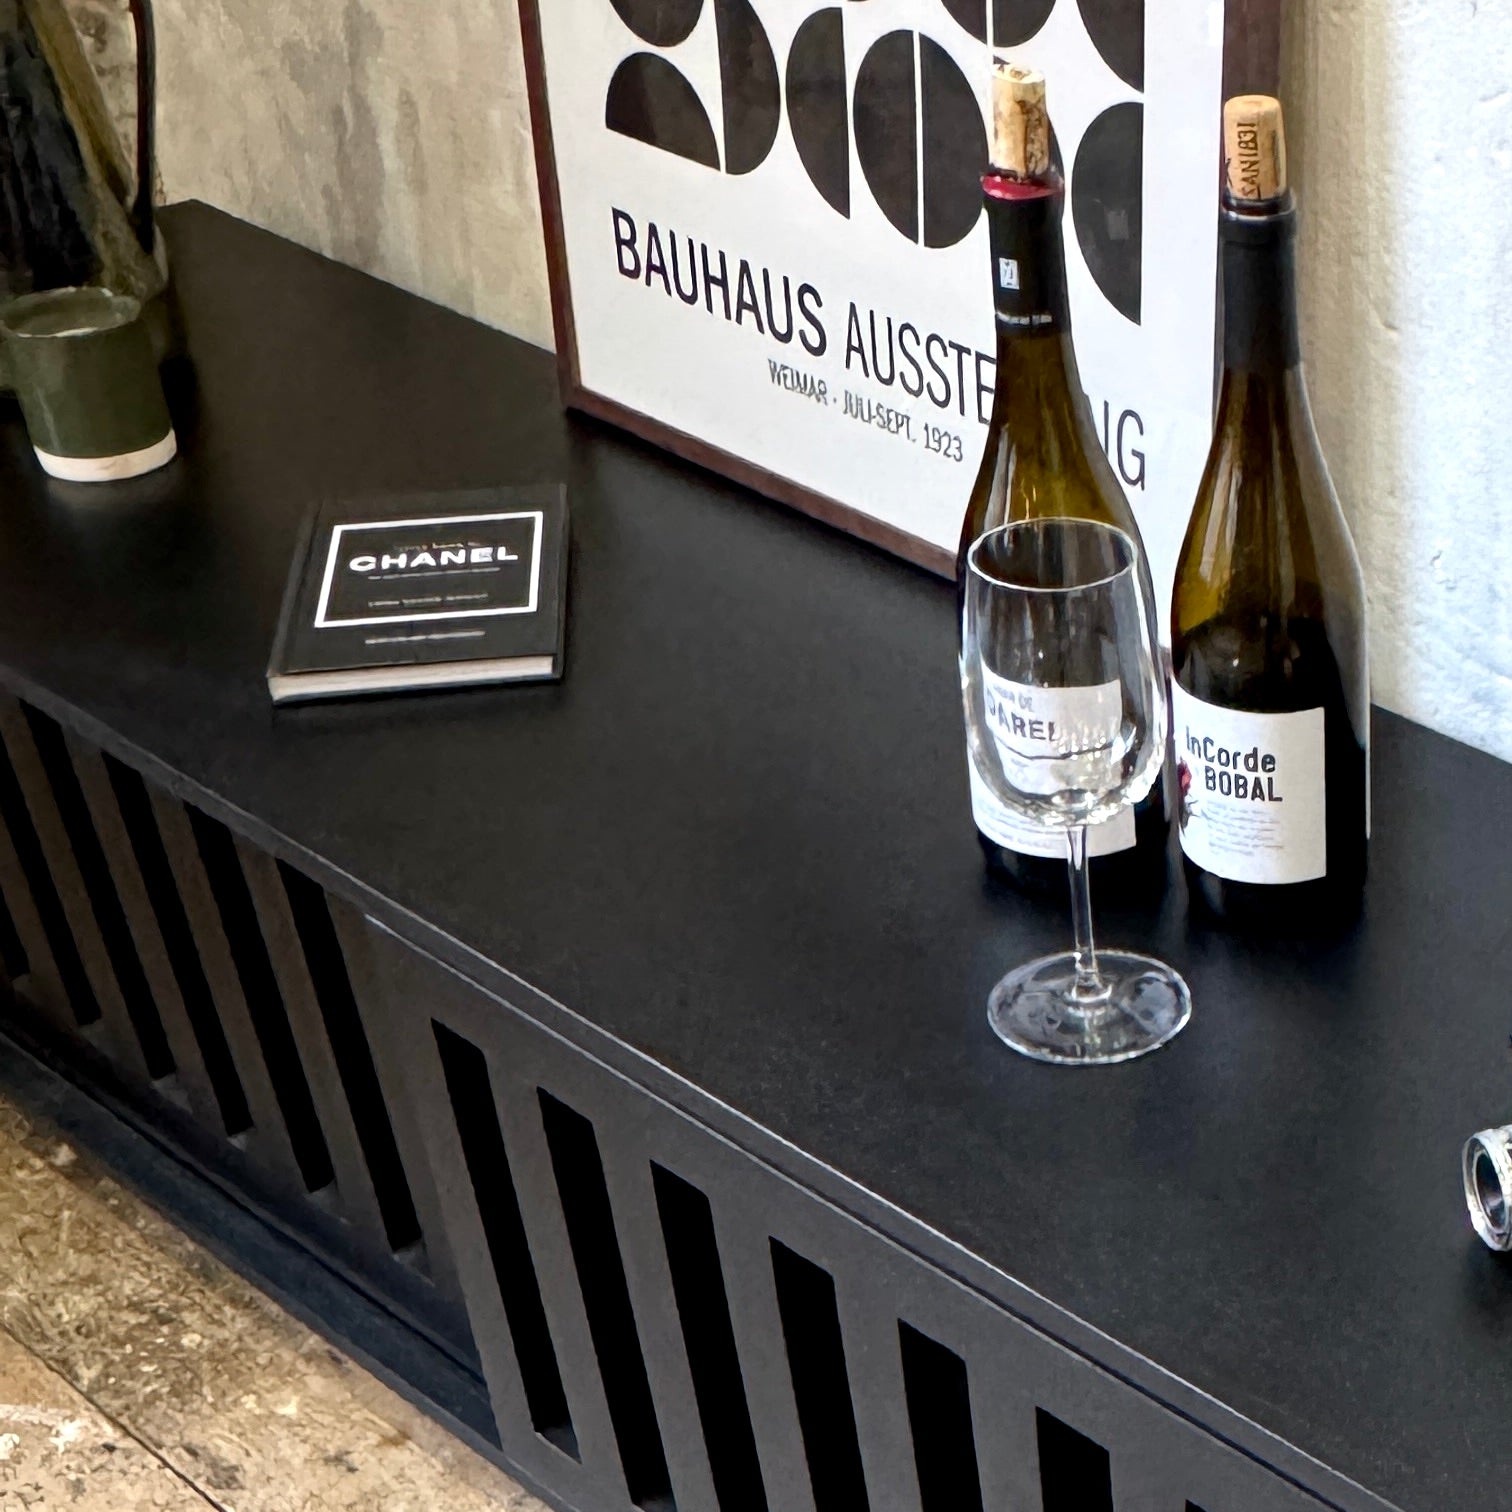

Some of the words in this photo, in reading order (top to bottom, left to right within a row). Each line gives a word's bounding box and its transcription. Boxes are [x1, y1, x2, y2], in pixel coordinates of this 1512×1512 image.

[611, 206, 828, 357] BAUHAUS
[767, 358, 829, 406] WEIMAR
[924, 422, 964, 463] 1923
[349, 546, 519, 572] CHANEL
[1185, 725, 1276, 773] InCorde
[1204, 765, 1283, 802] BOBAL
